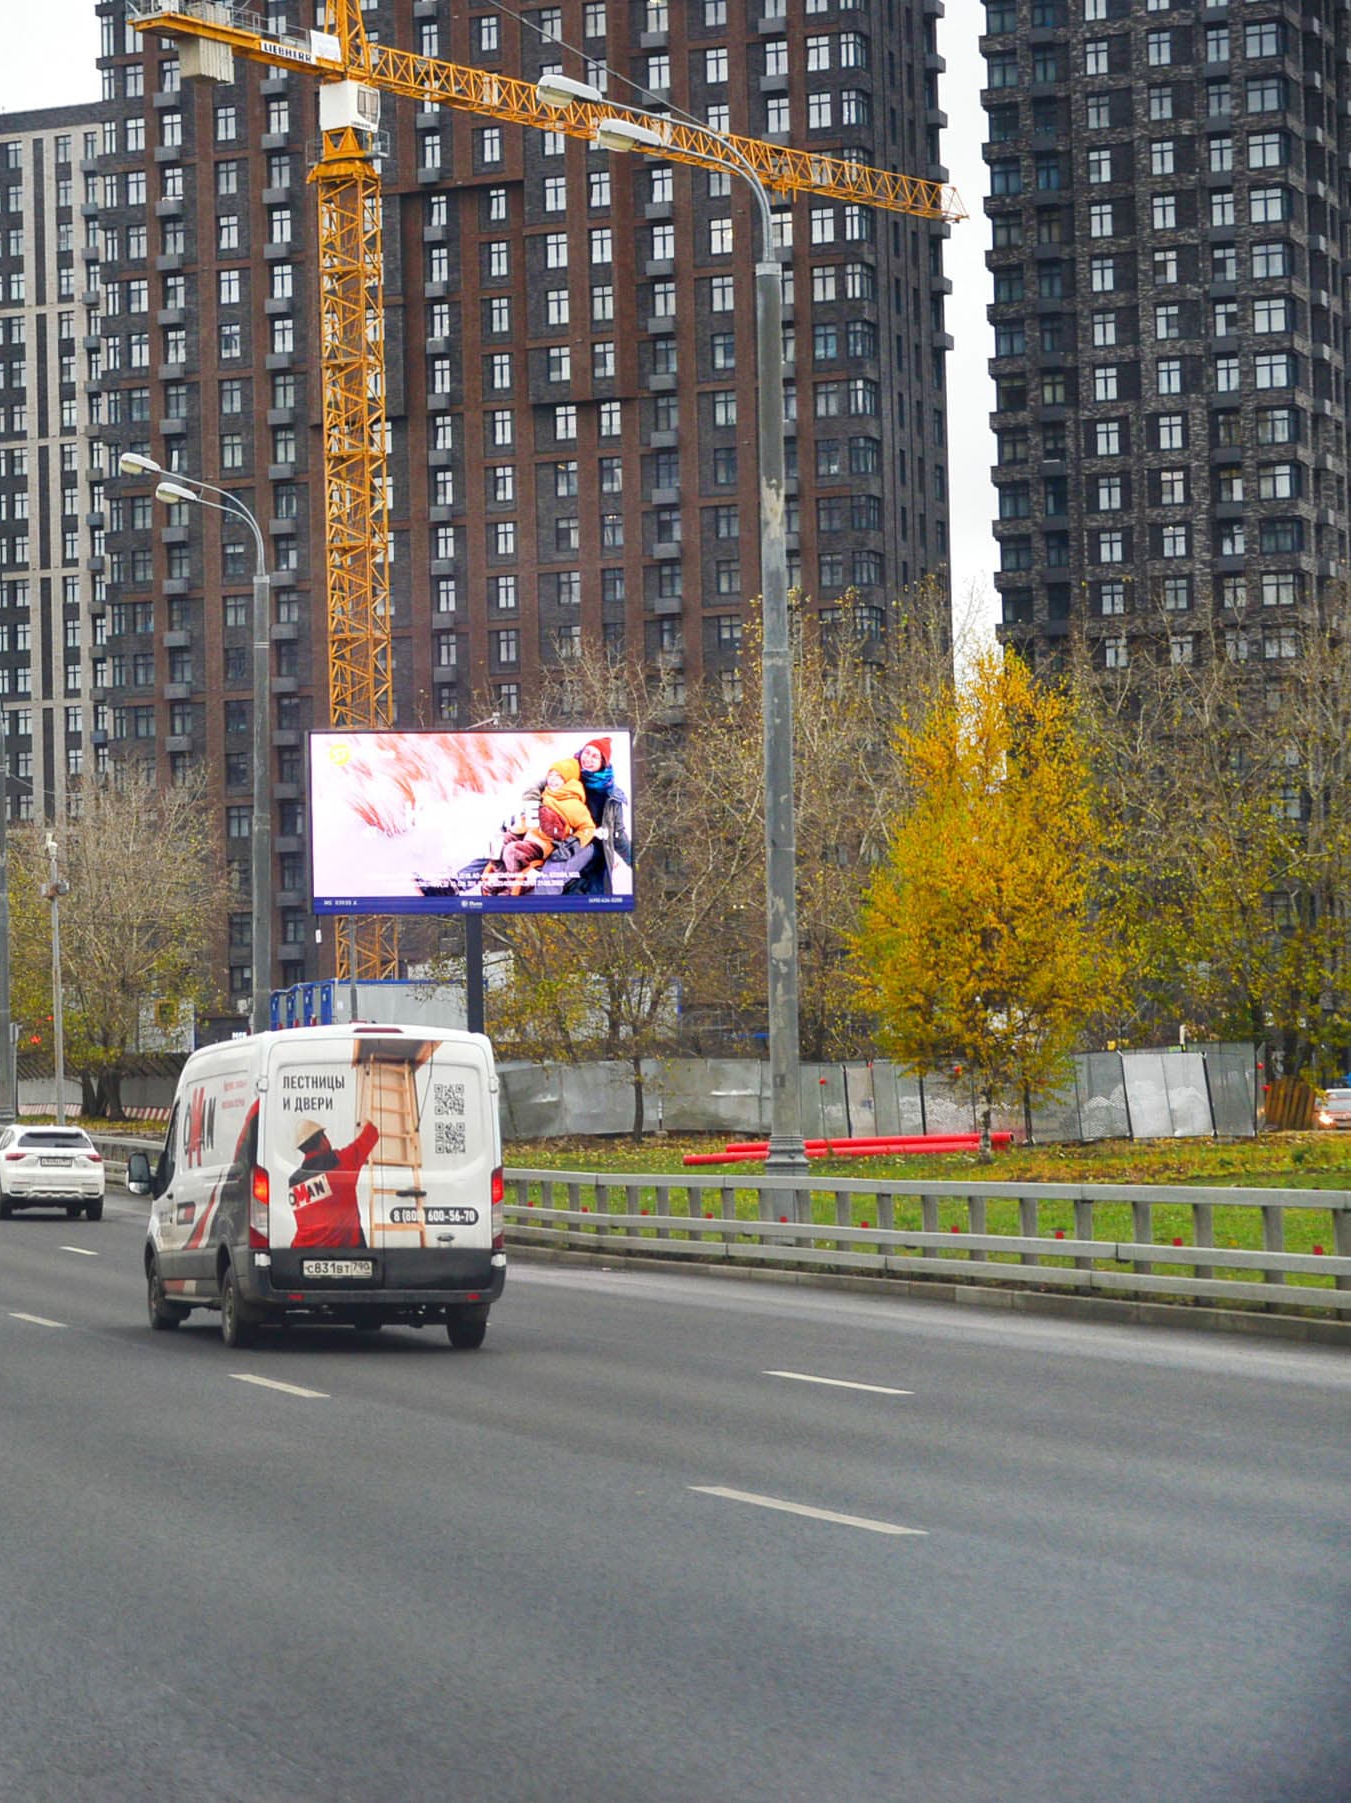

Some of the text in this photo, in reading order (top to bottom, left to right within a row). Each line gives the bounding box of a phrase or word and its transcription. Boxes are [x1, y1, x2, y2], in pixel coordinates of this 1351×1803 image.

[282, 1075, 345, 1092] ЛЕСТНИЦЫ
[282, 1096, 333, 1112] И ДВЕРИ
[288, 1180, 326, 1207] OMAN
[393, 1209, 400, 1222] 8
[427, 1209, 475, 1222] 600-56-70
